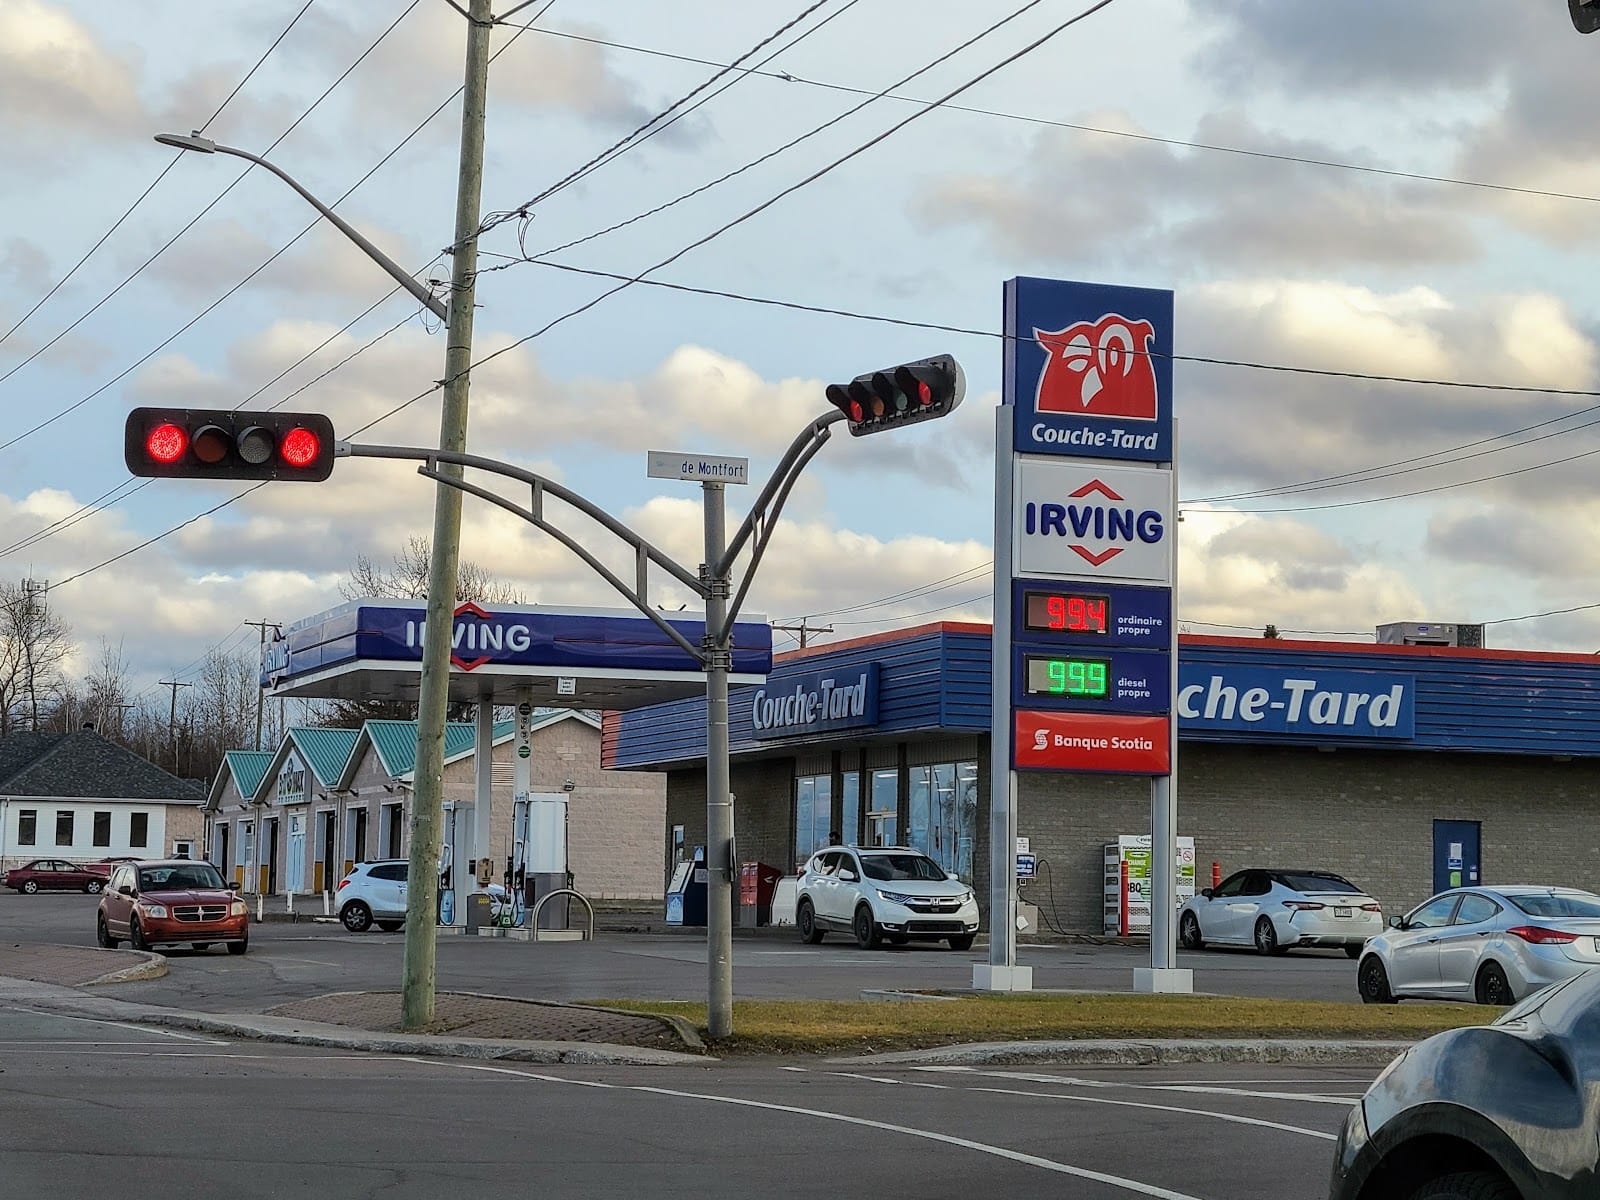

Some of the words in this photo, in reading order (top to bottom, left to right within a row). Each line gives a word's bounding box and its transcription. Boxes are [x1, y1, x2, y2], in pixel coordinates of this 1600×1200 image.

[1032, 423, 1158, 449] Couche-Tard
[682, 461, 694, 473] de
[698, 461, 744, 477] Montfort
[1026, 502, 1163, 543] IRVING
[1117, 616, 1162, 626] ordinaire
[406, 620, 531, 652] IVING
[1117, 626, 1150, 635] propre
[1117, 677, 1147, 688] diesel
[1117, 688, 1150, 698] propre
[752, 674, 867, 729] Couche-Tard
[1177, 676, 1404, 727] che-Tard
[1054, 734, 1107, 750] Banque
[1111, 737, 1153, 750] Scotia
[1128, 882, 1142, 893] BQ
